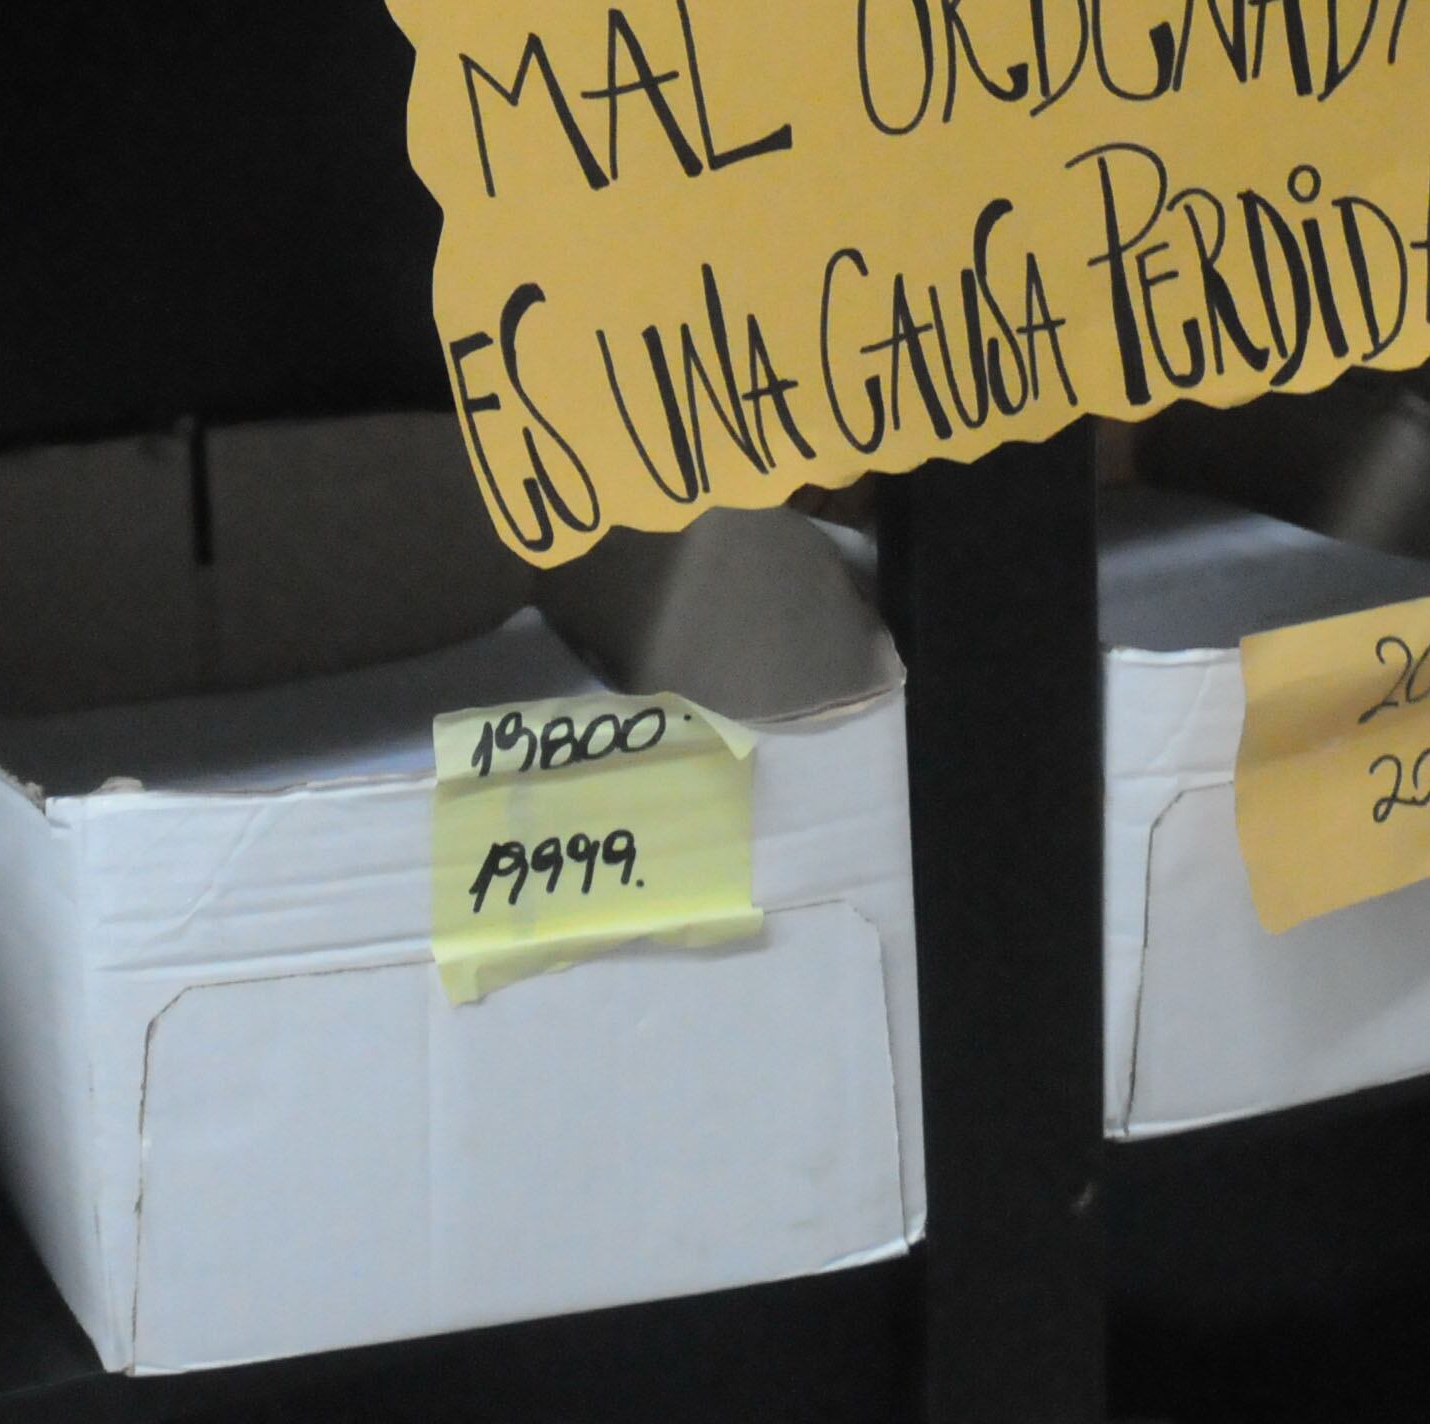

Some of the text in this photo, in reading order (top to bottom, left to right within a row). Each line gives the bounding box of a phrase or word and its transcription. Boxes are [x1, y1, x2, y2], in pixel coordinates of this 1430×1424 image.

[449, 282, 600, 553] ES
[597, 263, 815, 504] UNA
[820, 198, 1078, 453] CAUSA
[468, 829, 645, 914] 19999.
